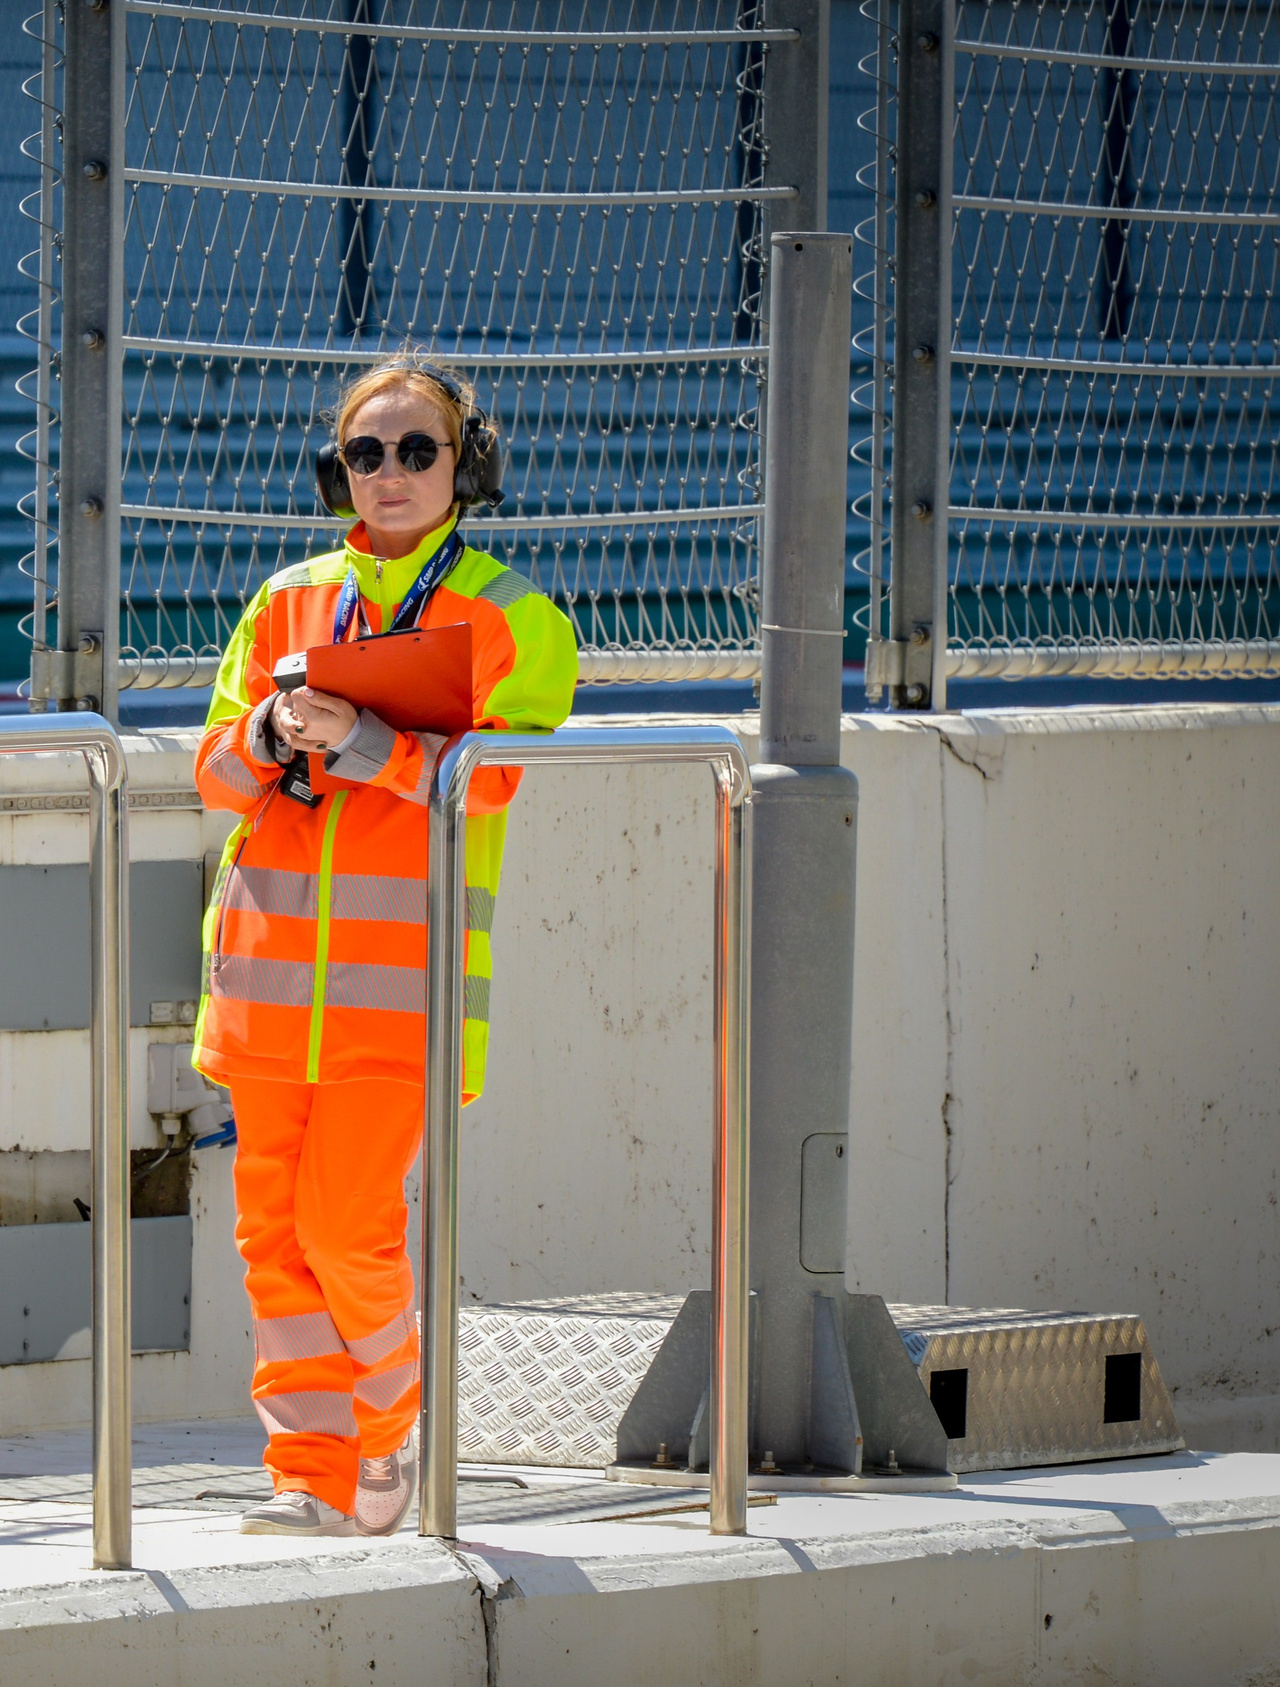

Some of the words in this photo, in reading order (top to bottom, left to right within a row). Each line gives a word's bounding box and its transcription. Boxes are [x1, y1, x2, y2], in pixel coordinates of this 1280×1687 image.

[424, 567, 435, 583] SMP
[345, 586, 354, 602] SMP
[340, 601, 350, 627] RACING
